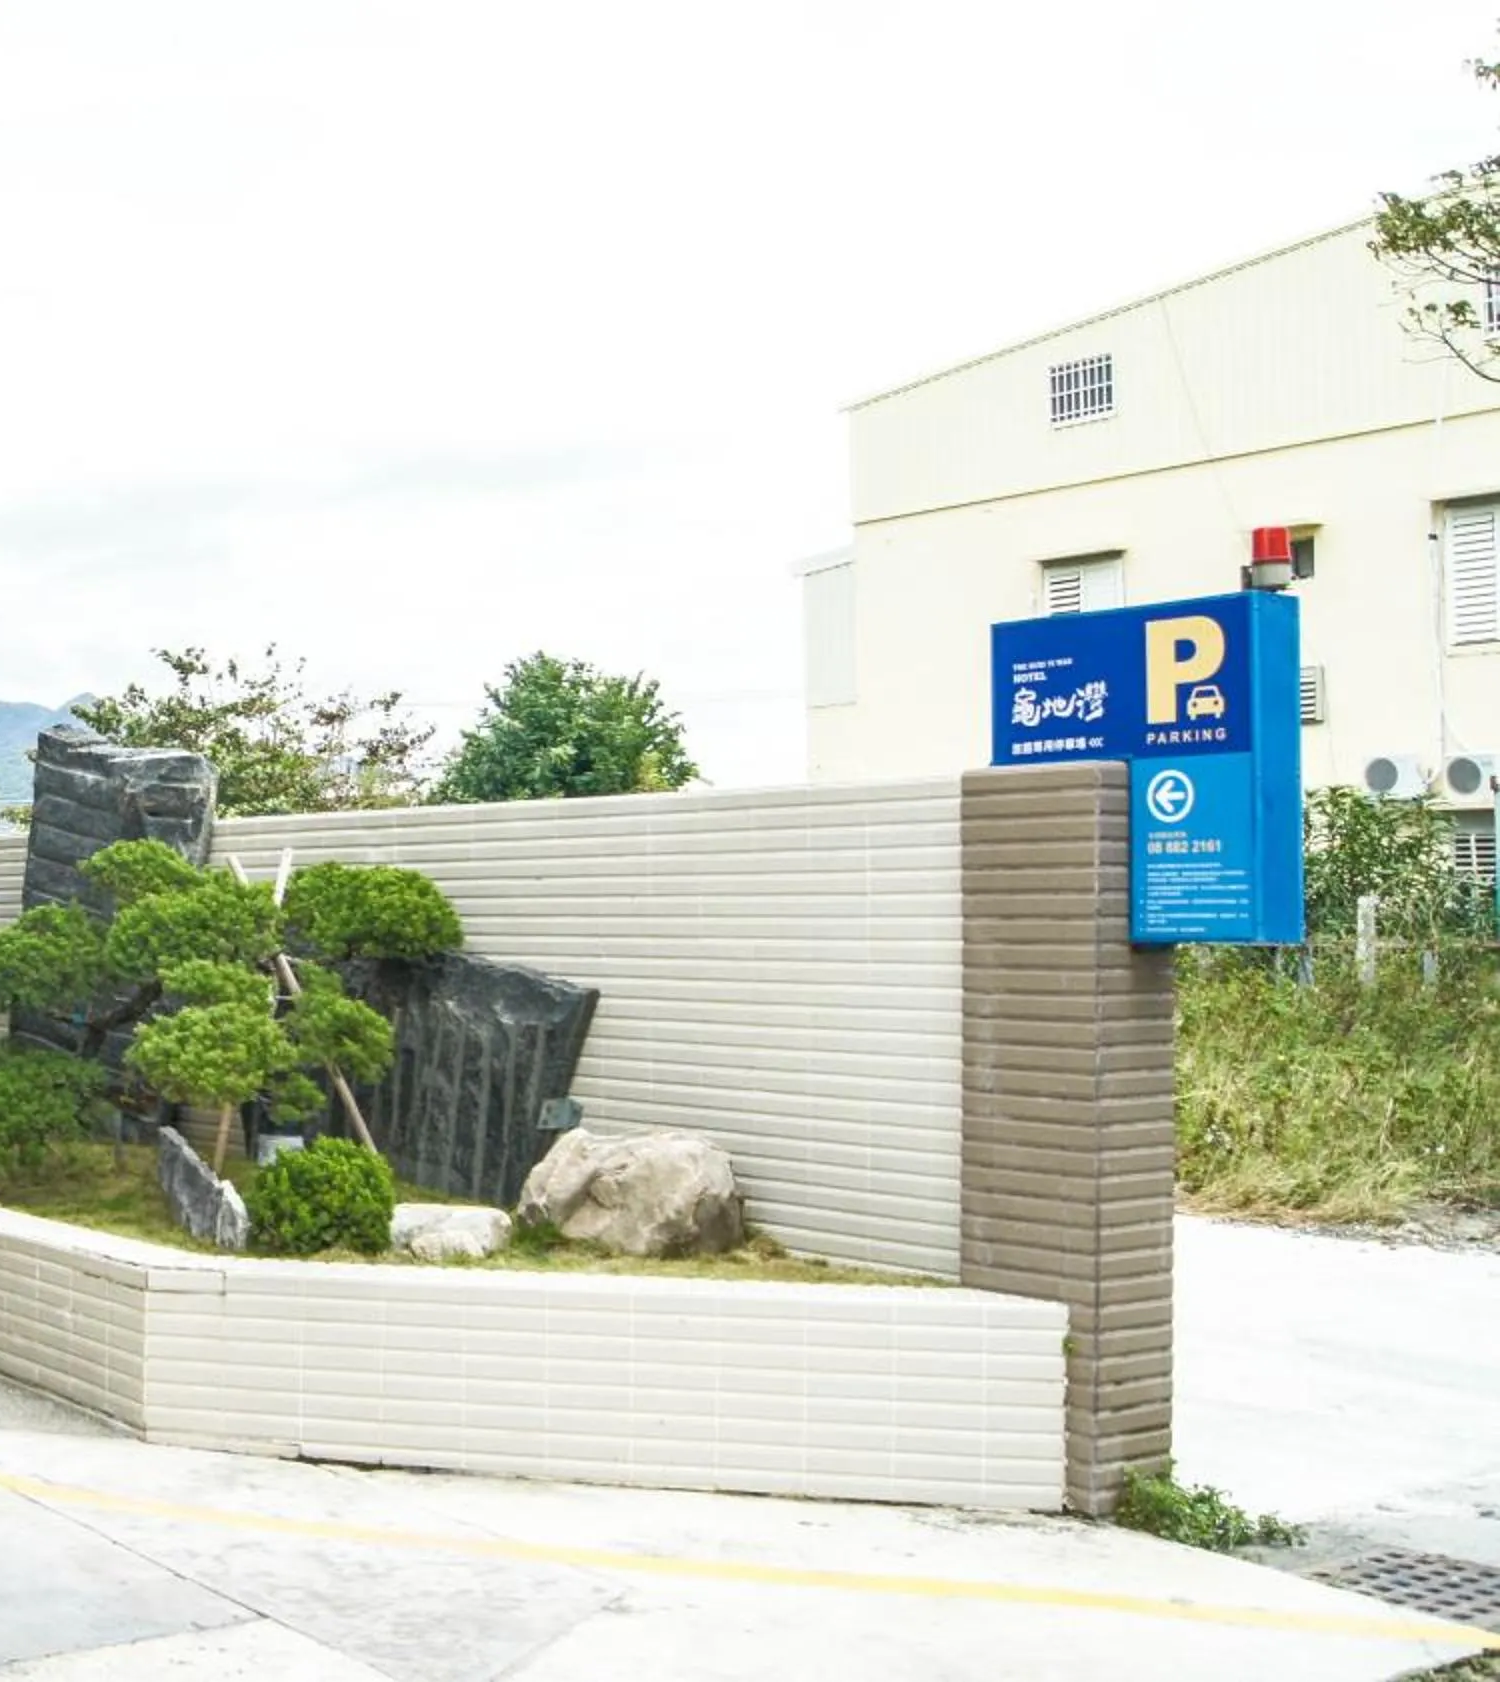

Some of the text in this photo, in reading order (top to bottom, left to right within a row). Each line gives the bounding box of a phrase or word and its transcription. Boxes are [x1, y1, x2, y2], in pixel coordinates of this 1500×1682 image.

[1013, 672, 1047, 683] HOTEL
[1145, 615, 1225, 724] P
[1146, 728, 1227, 744] PARKING
